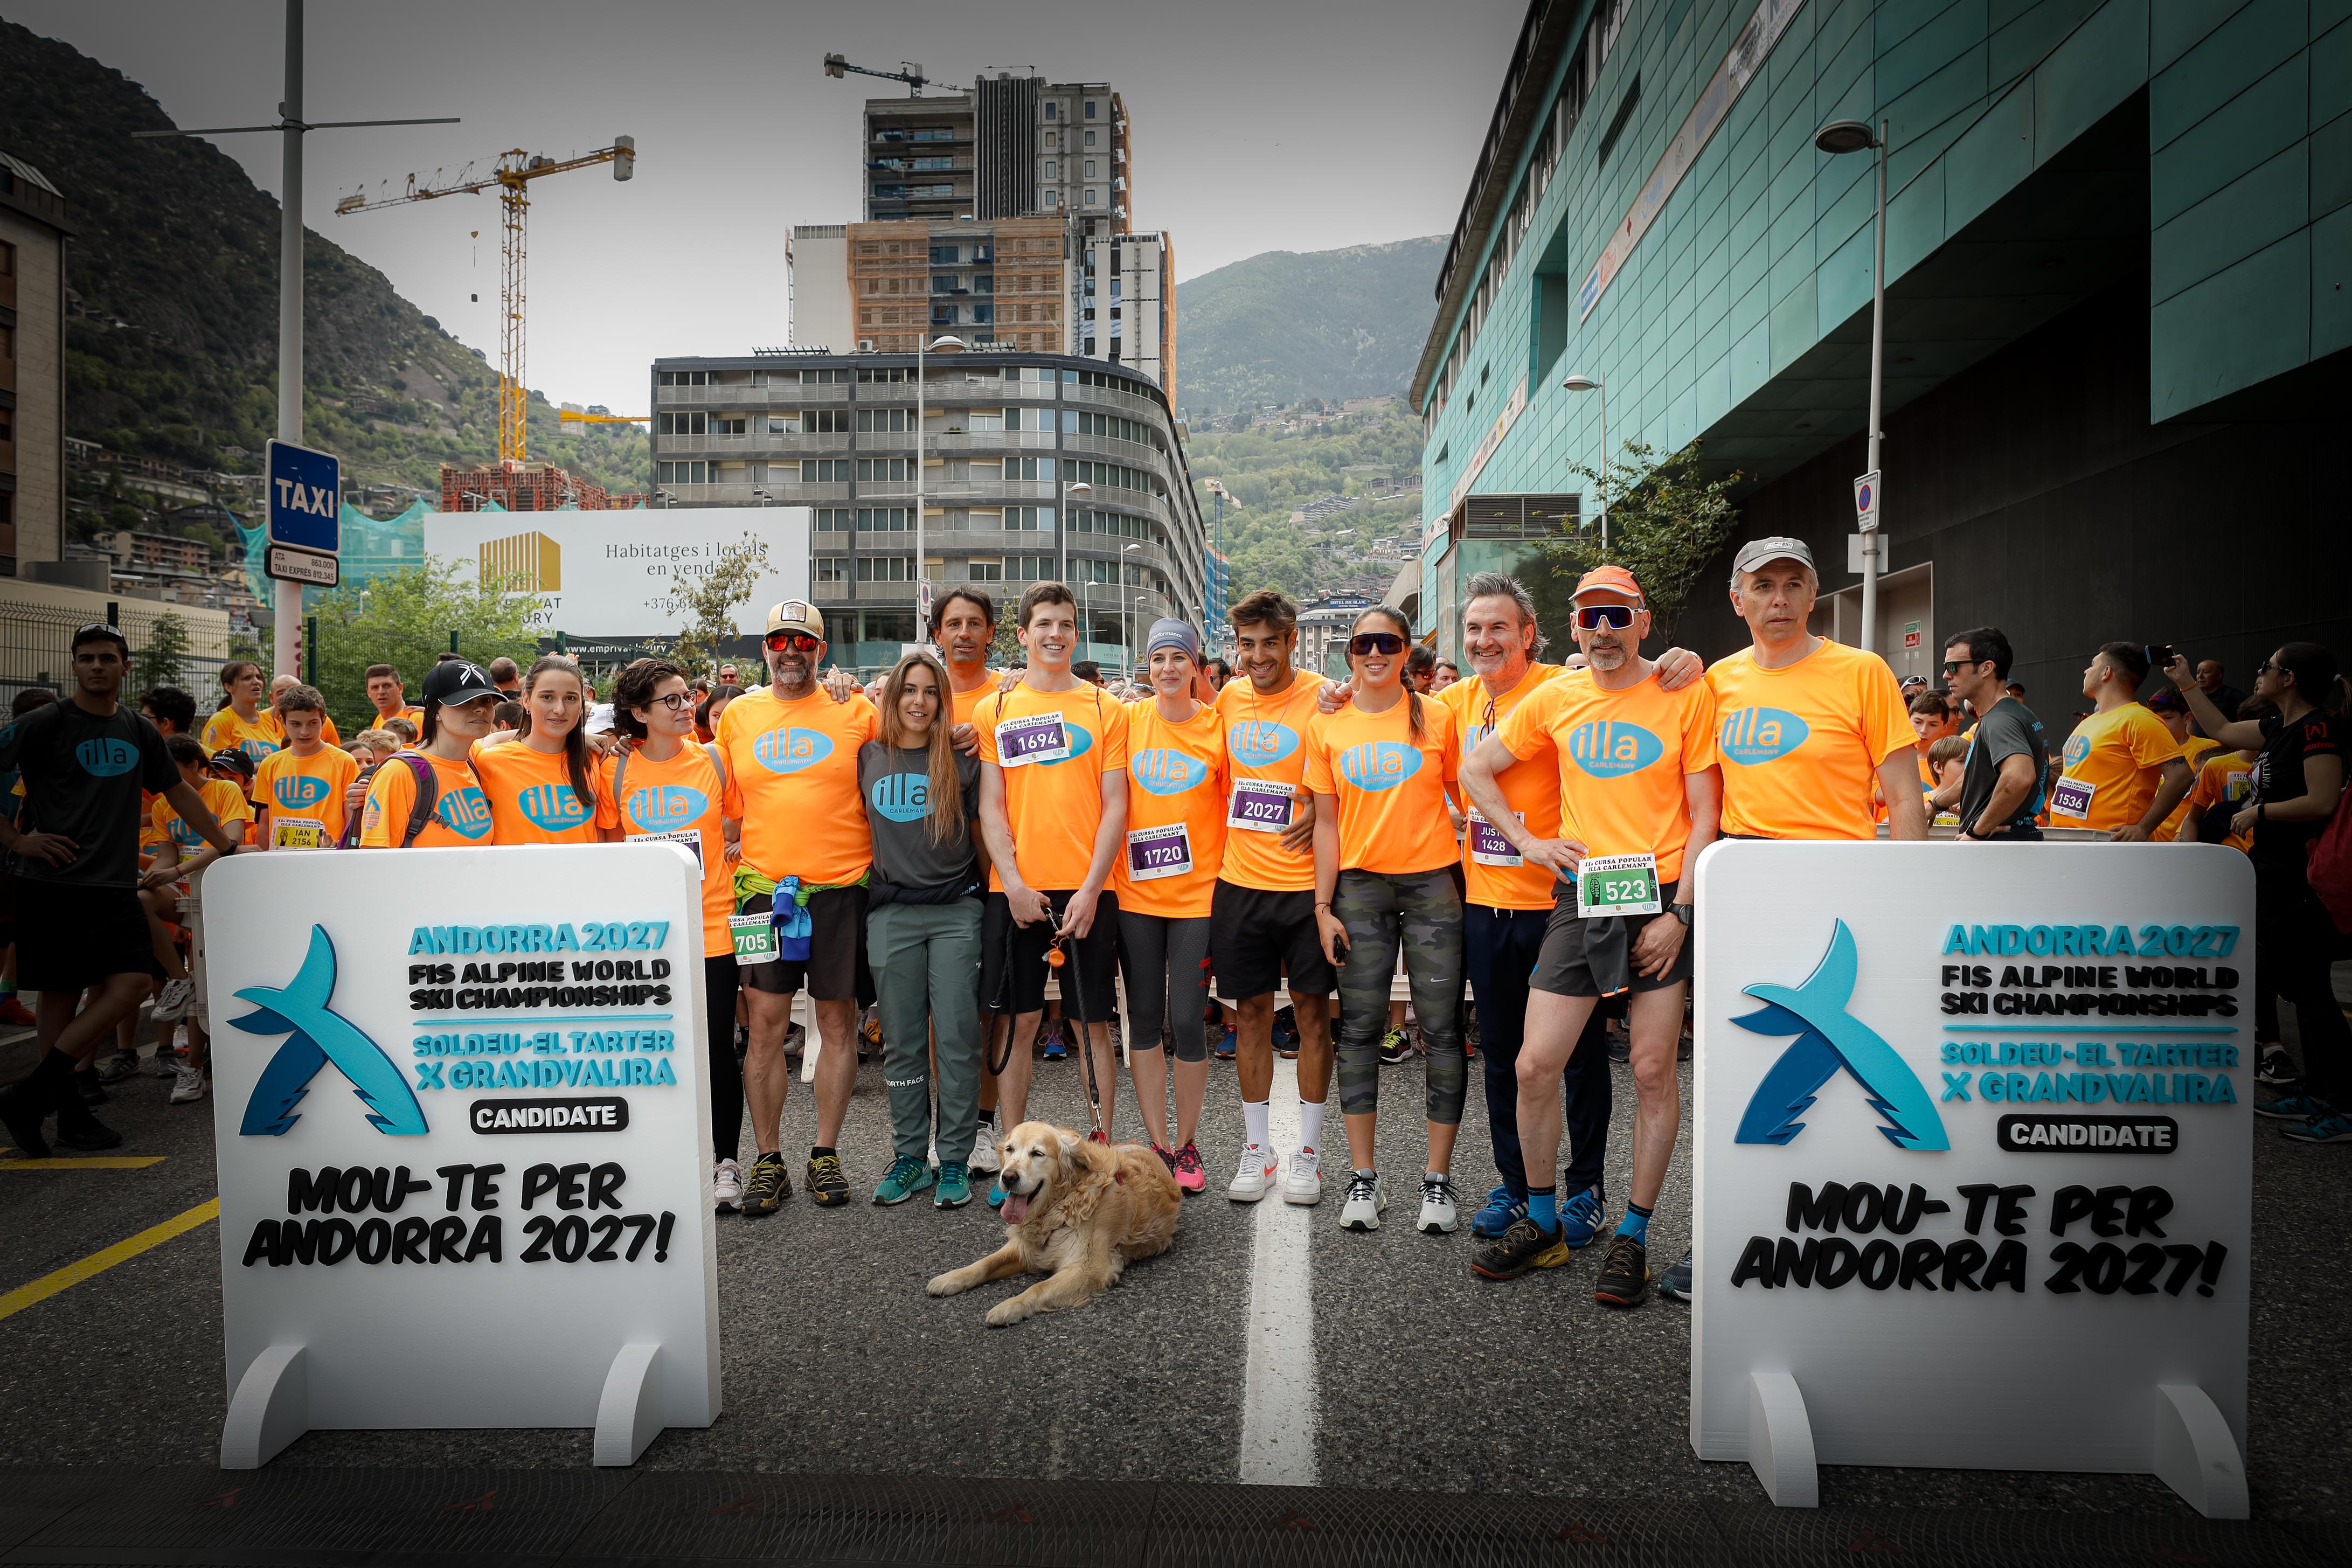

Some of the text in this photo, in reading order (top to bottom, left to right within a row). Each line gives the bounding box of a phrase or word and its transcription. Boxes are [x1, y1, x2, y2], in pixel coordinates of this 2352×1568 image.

[275, 477, 334, 518] TAXI
[275, 552, 334, 570] ATA 863.000
[606, 544, 698, 561] Habitatges
[705, 543, 710, 556] i
[274, 564, 334, 581] TAXI EXPRÉS 812.345
[647, 564, 667, 575] en
[643, 598, 674, 609] +376
[1010, 718, 1030, 726] CURSA
[1031, 714, 1059, 722] POPULAR
[1019, 719, 1056, 728] CARLEMANY
[1725, 706, 1781, 746] illa
[245, 739, 273, 755] illa
[761, 728, 813, 759] illa
[1018, 731, 1058, 751] 1694
[1234, 720, 1279, 752] illa
[1578, 720, 1638, 760] illa
[84, 738, 127, 765] illa
[1348, 742, 1402, 778] illa
[1139, 749, 1188, 781] illa
[279, 776, 315, 799] illa
[879, 773, 927, 806] illa
[1148, 780, 1186, 788] CARLEMANY
[1252, 787, 1288, 795] CARLEMANY
[2073, 781, 2093, 789] POPULAR
[445, 788, 490, 825] illa
[527, 784, 583, 816] illa
[635, 786, 688, 820] illa
[1244, 801, 1285, 820] 2027
[2059, 793, 2083, 809] 1536
[648, 817, 688, 826] CARLEMANY
[1156, 825, 1183, 834] POPULAR
[1145, 831, 1180, 840] CARLEMANY
[1482, 839, 1505, 851] 1428
[1144, 845, 1182, 865] 1720
[1605, 879, 1647, 901] 523
[1650, 879, 1656, 889] 5K
[407, 920, 670, 955] ANDORRA 2027
[735, 933, 767, 953] 705
[770, 933, 775, 942] 5K
[1941, 924, 2240, 957] ANDORRA 2027
[408, 959, 671, 985] FIS ALPINE WORLD
[1941, 965, 2239, 989] FIS ALPINE WORLD
[409, 984, 672, 1010] SKI CHAMPIONSHIPS
[1941, 993, 2238, 1017] SKI CHAMPIONSHIPS
[567, 1030, 675, 1053] TARTER
[2117, 1043, 2239, 1067] TARTER
[414, 1057, 677, 1091] X GRANDVALIRA
[907, 1074, 924, 1086] FACE
[1941, 1071, 2238, 1105] X GRANDVALIRA
[476, 1105, 618, 1128] CANDIDATE
[2010, 1123, 2171, 1147] CANDIDATE
[521, 1162, 627, 1211] PER
[2050, 1184, 2174, 1239] PER
[241, 1211, 676, 1267] ANDORRA 2027!
[1731, 1236, 2229, 1298] ANDORRA 2027!
